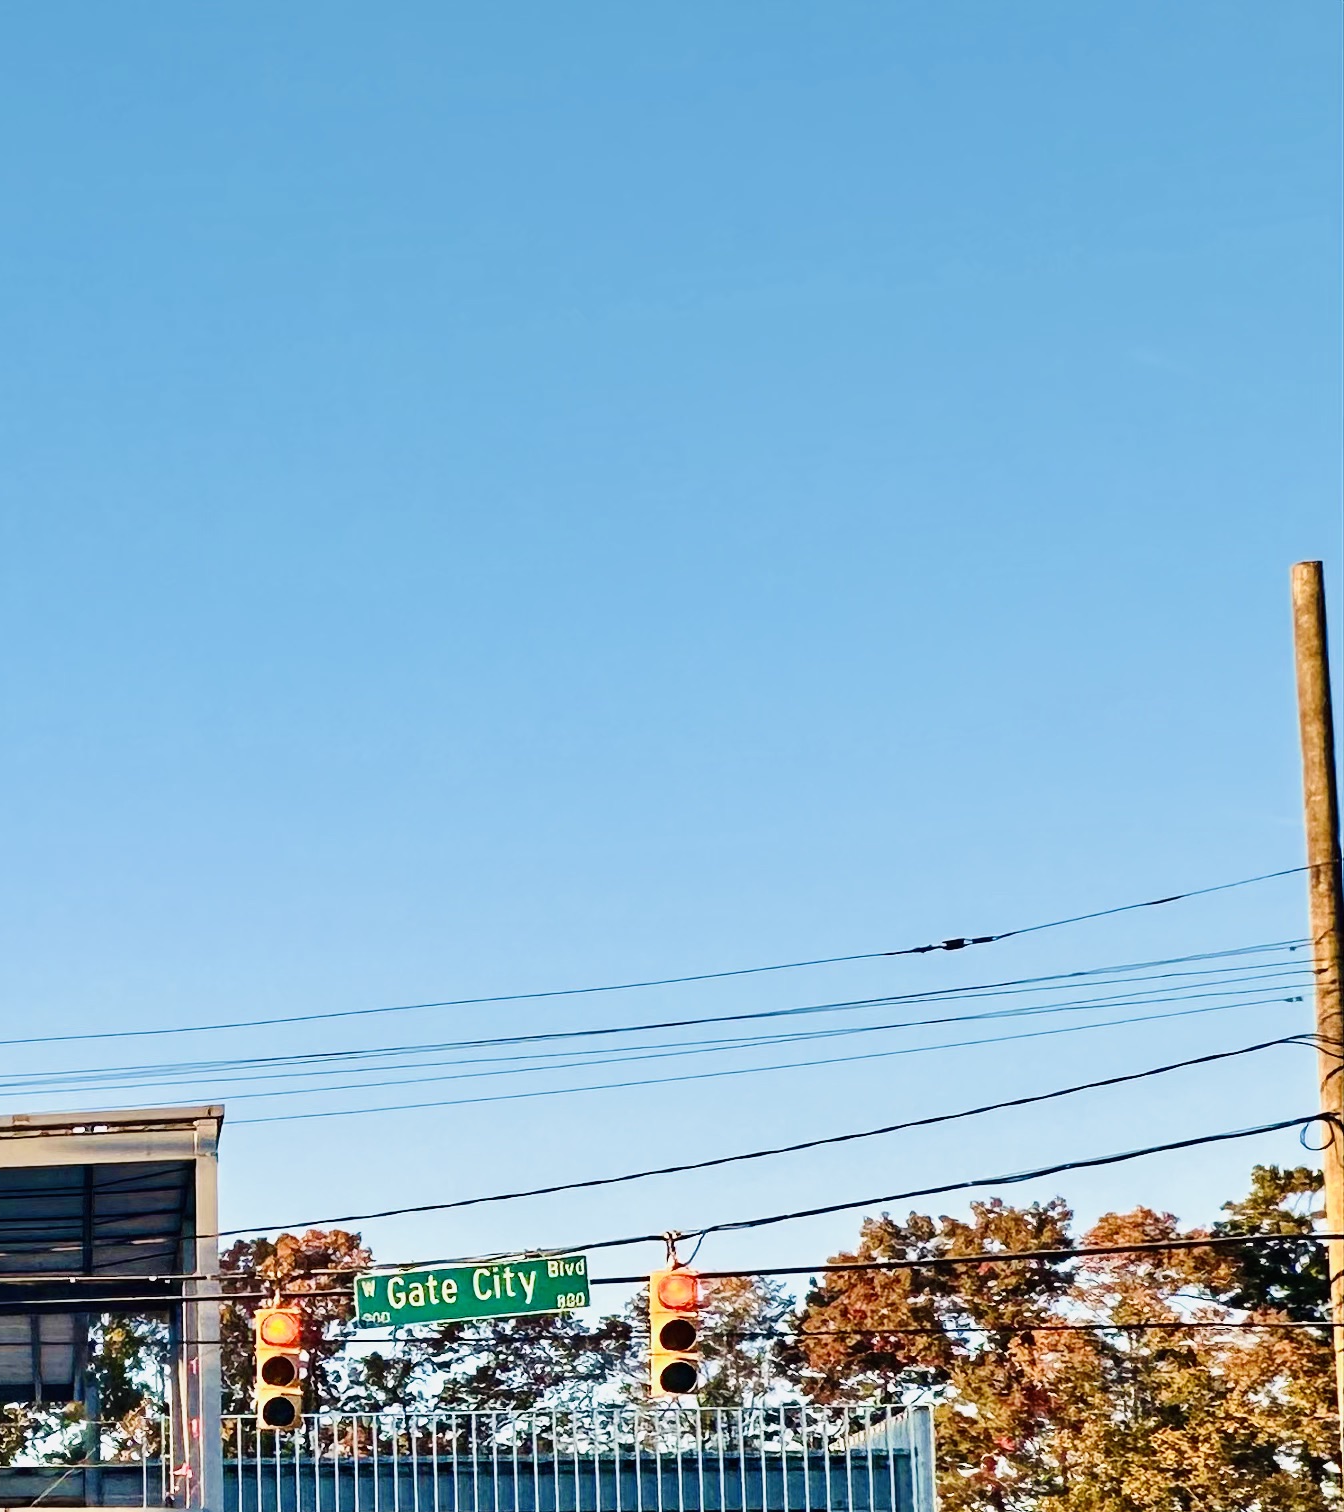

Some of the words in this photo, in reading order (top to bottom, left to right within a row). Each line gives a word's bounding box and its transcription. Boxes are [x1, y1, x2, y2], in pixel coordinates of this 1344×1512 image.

[361, 1279, 376, 1297] W
[387, 1274, 459, 1309] Gate
[472, 1266, 537, 1304] City
[547, 1259, 585, 1278] Blvd
